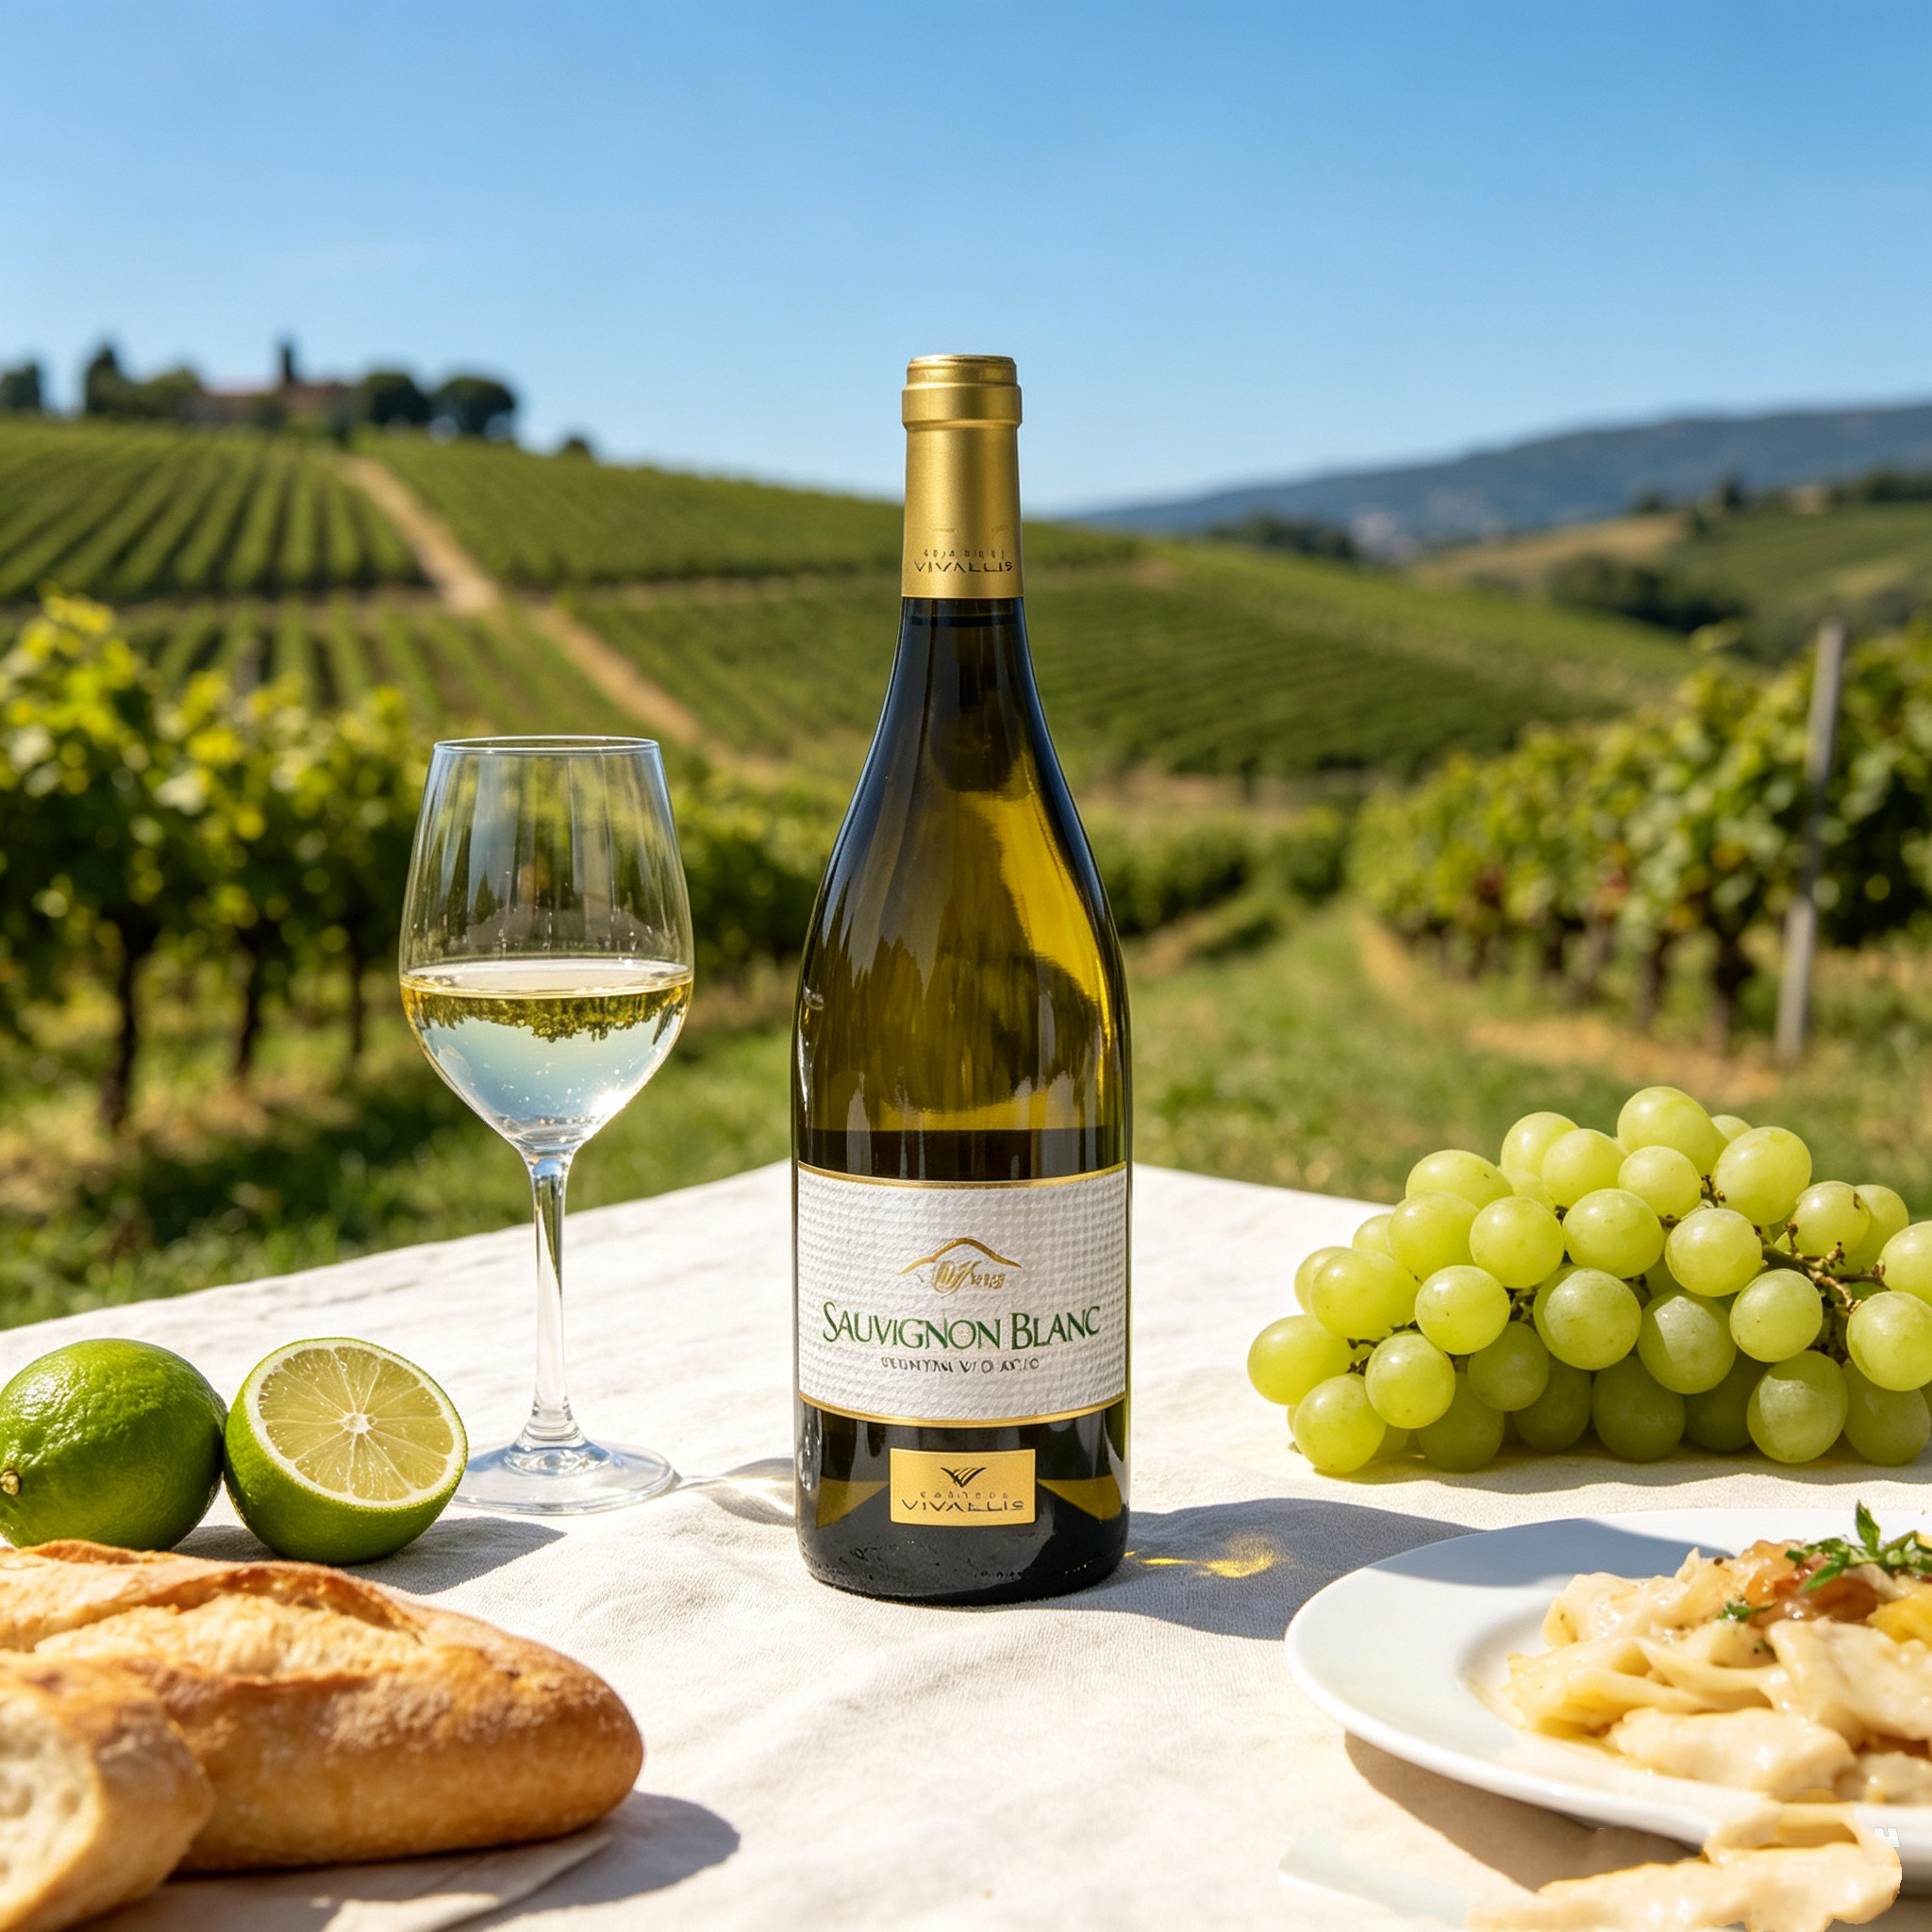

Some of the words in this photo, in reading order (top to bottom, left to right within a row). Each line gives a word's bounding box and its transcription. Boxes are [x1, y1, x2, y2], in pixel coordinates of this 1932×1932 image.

[913, 560, 1013, 573] VIVALLIS
[823, 1301, 1001, 1350] SAUVIGNON
[1010, 1306, 1102, 1350] BLANC
